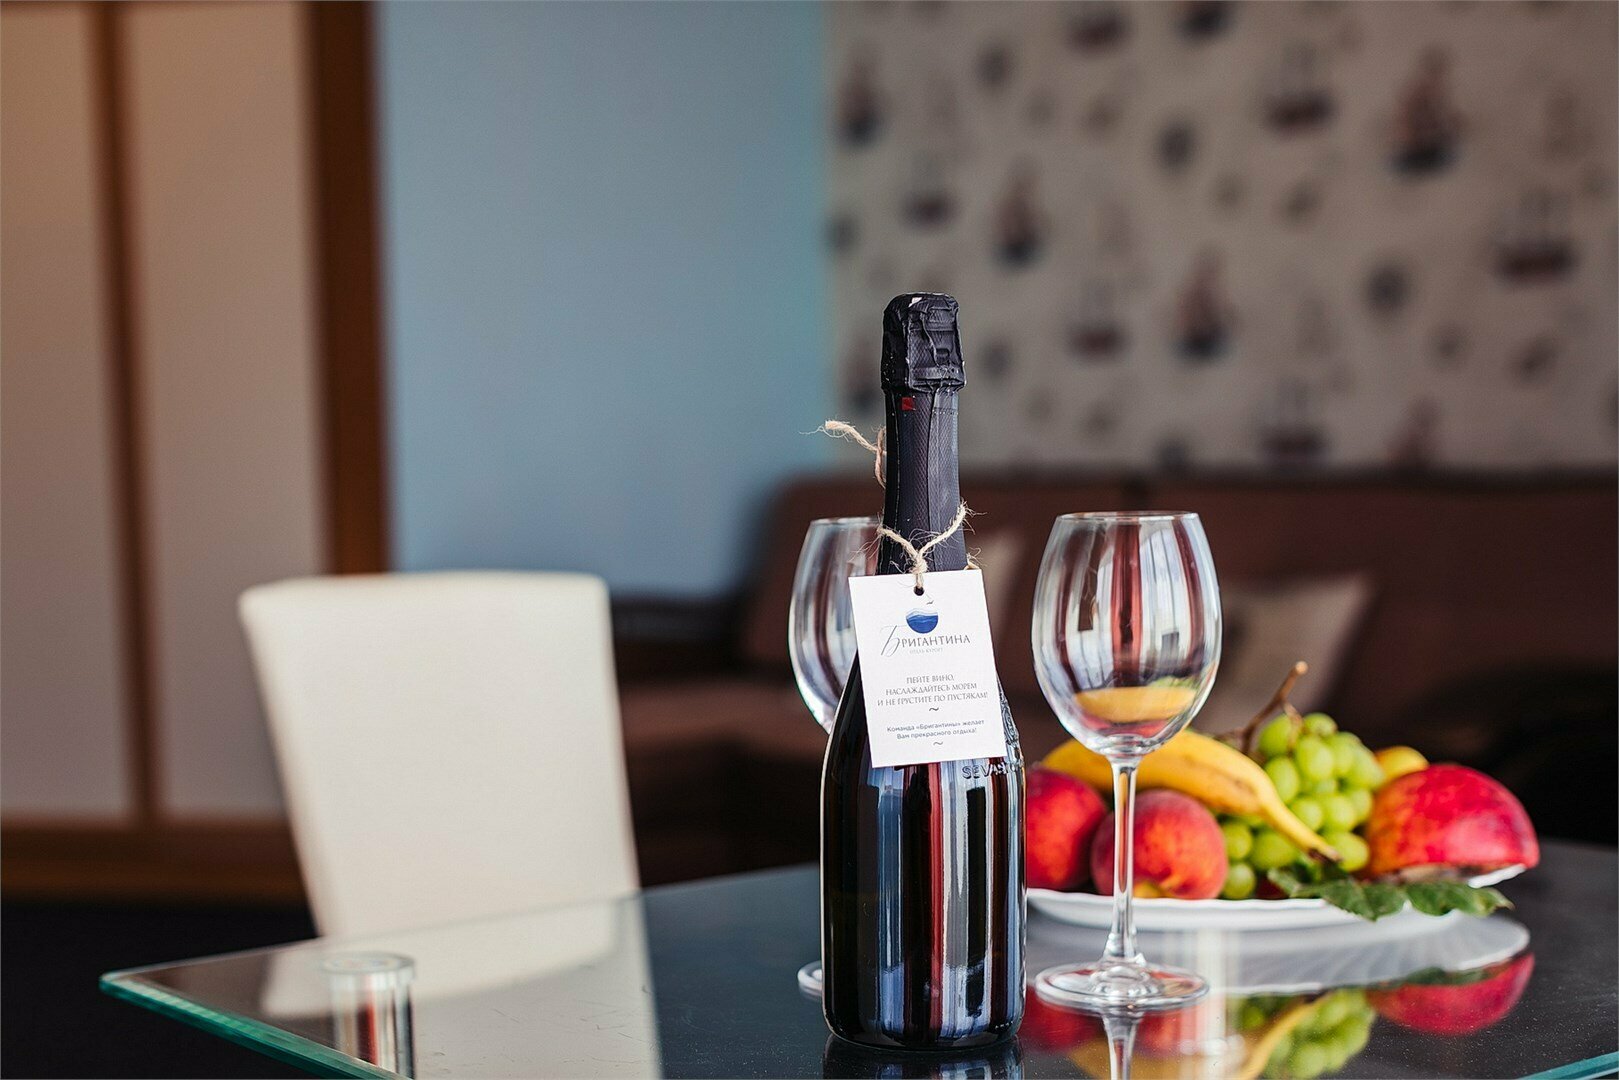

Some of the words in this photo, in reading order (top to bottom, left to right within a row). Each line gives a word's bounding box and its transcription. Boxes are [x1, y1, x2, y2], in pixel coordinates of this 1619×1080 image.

[906, 675, 930, 685] ПЕЙТЕ
[885, 684, 951, 696] НАСЛАЖДАЙТЕСЬ
[952, 682, 977, 691] МОРЕМ
[877, 699, 884, 707] И
[885, 698, 896, 706] НЕ
[897, 695, 932, 705] ГРУСТИТЕ
[934, 694, 946, 702] ПО
[947, 691, 988, 701] ПУСТЯКАМ!
[886, 725, 915, 733] Команда
[916, 721, 961, 731] «Бригантины»
[911, 730, 952, 739] прекрасного
[952, 727, 977, 736] отдыха!
